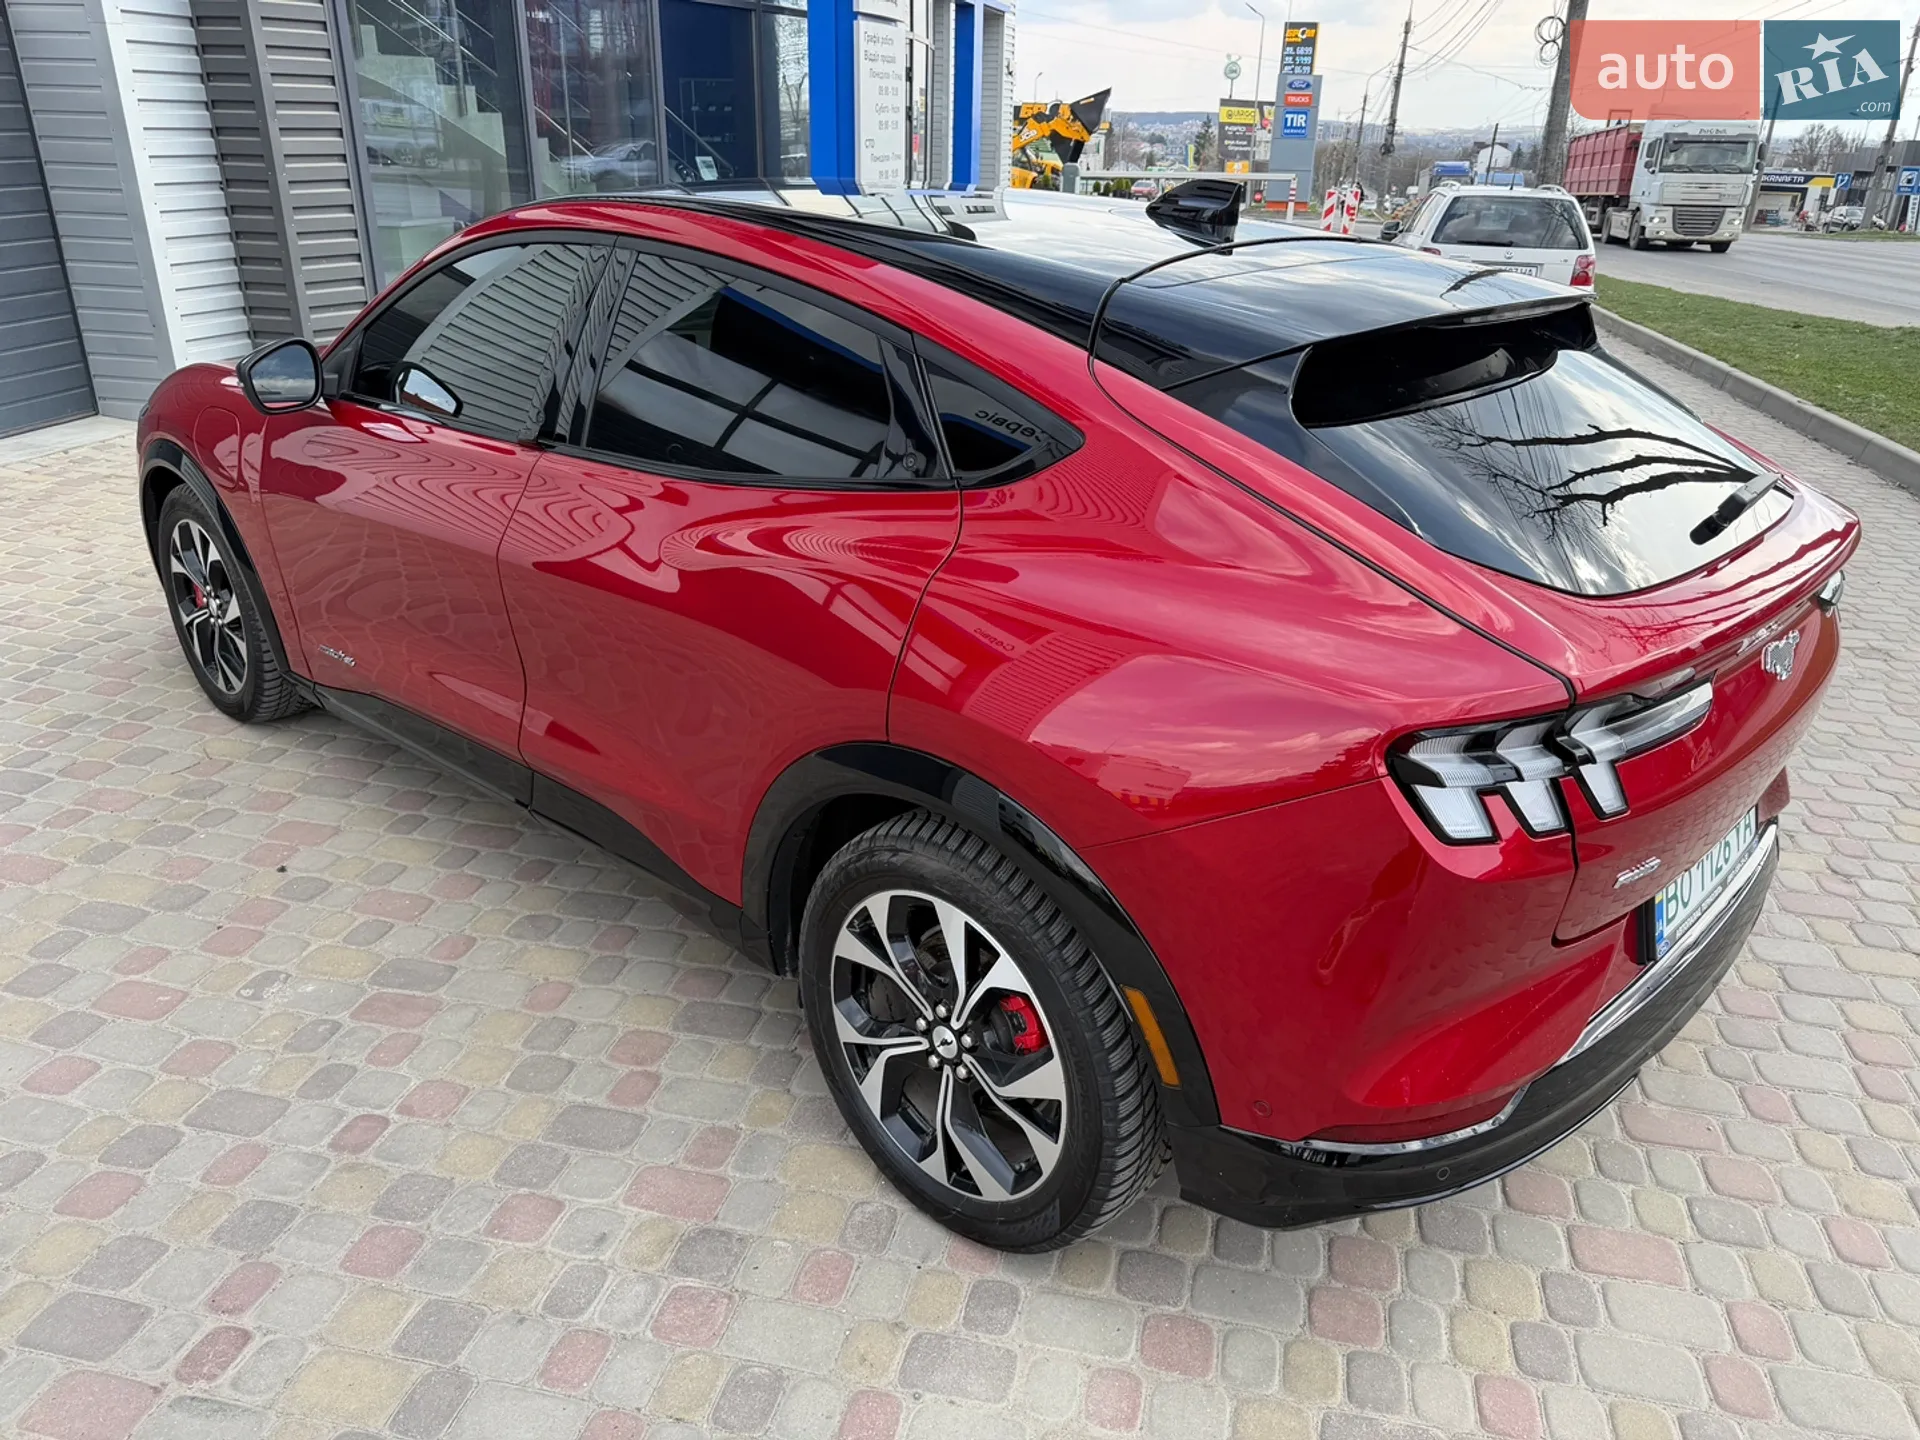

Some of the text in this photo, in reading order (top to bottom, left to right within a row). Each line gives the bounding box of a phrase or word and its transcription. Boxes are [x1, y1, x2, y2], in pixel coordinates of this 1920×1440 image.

[1291, 80, 1308, 88] Ford
[1287, 95, 1310, 103] TRUCKS
[1285, 113, 1307, 127] TIR
